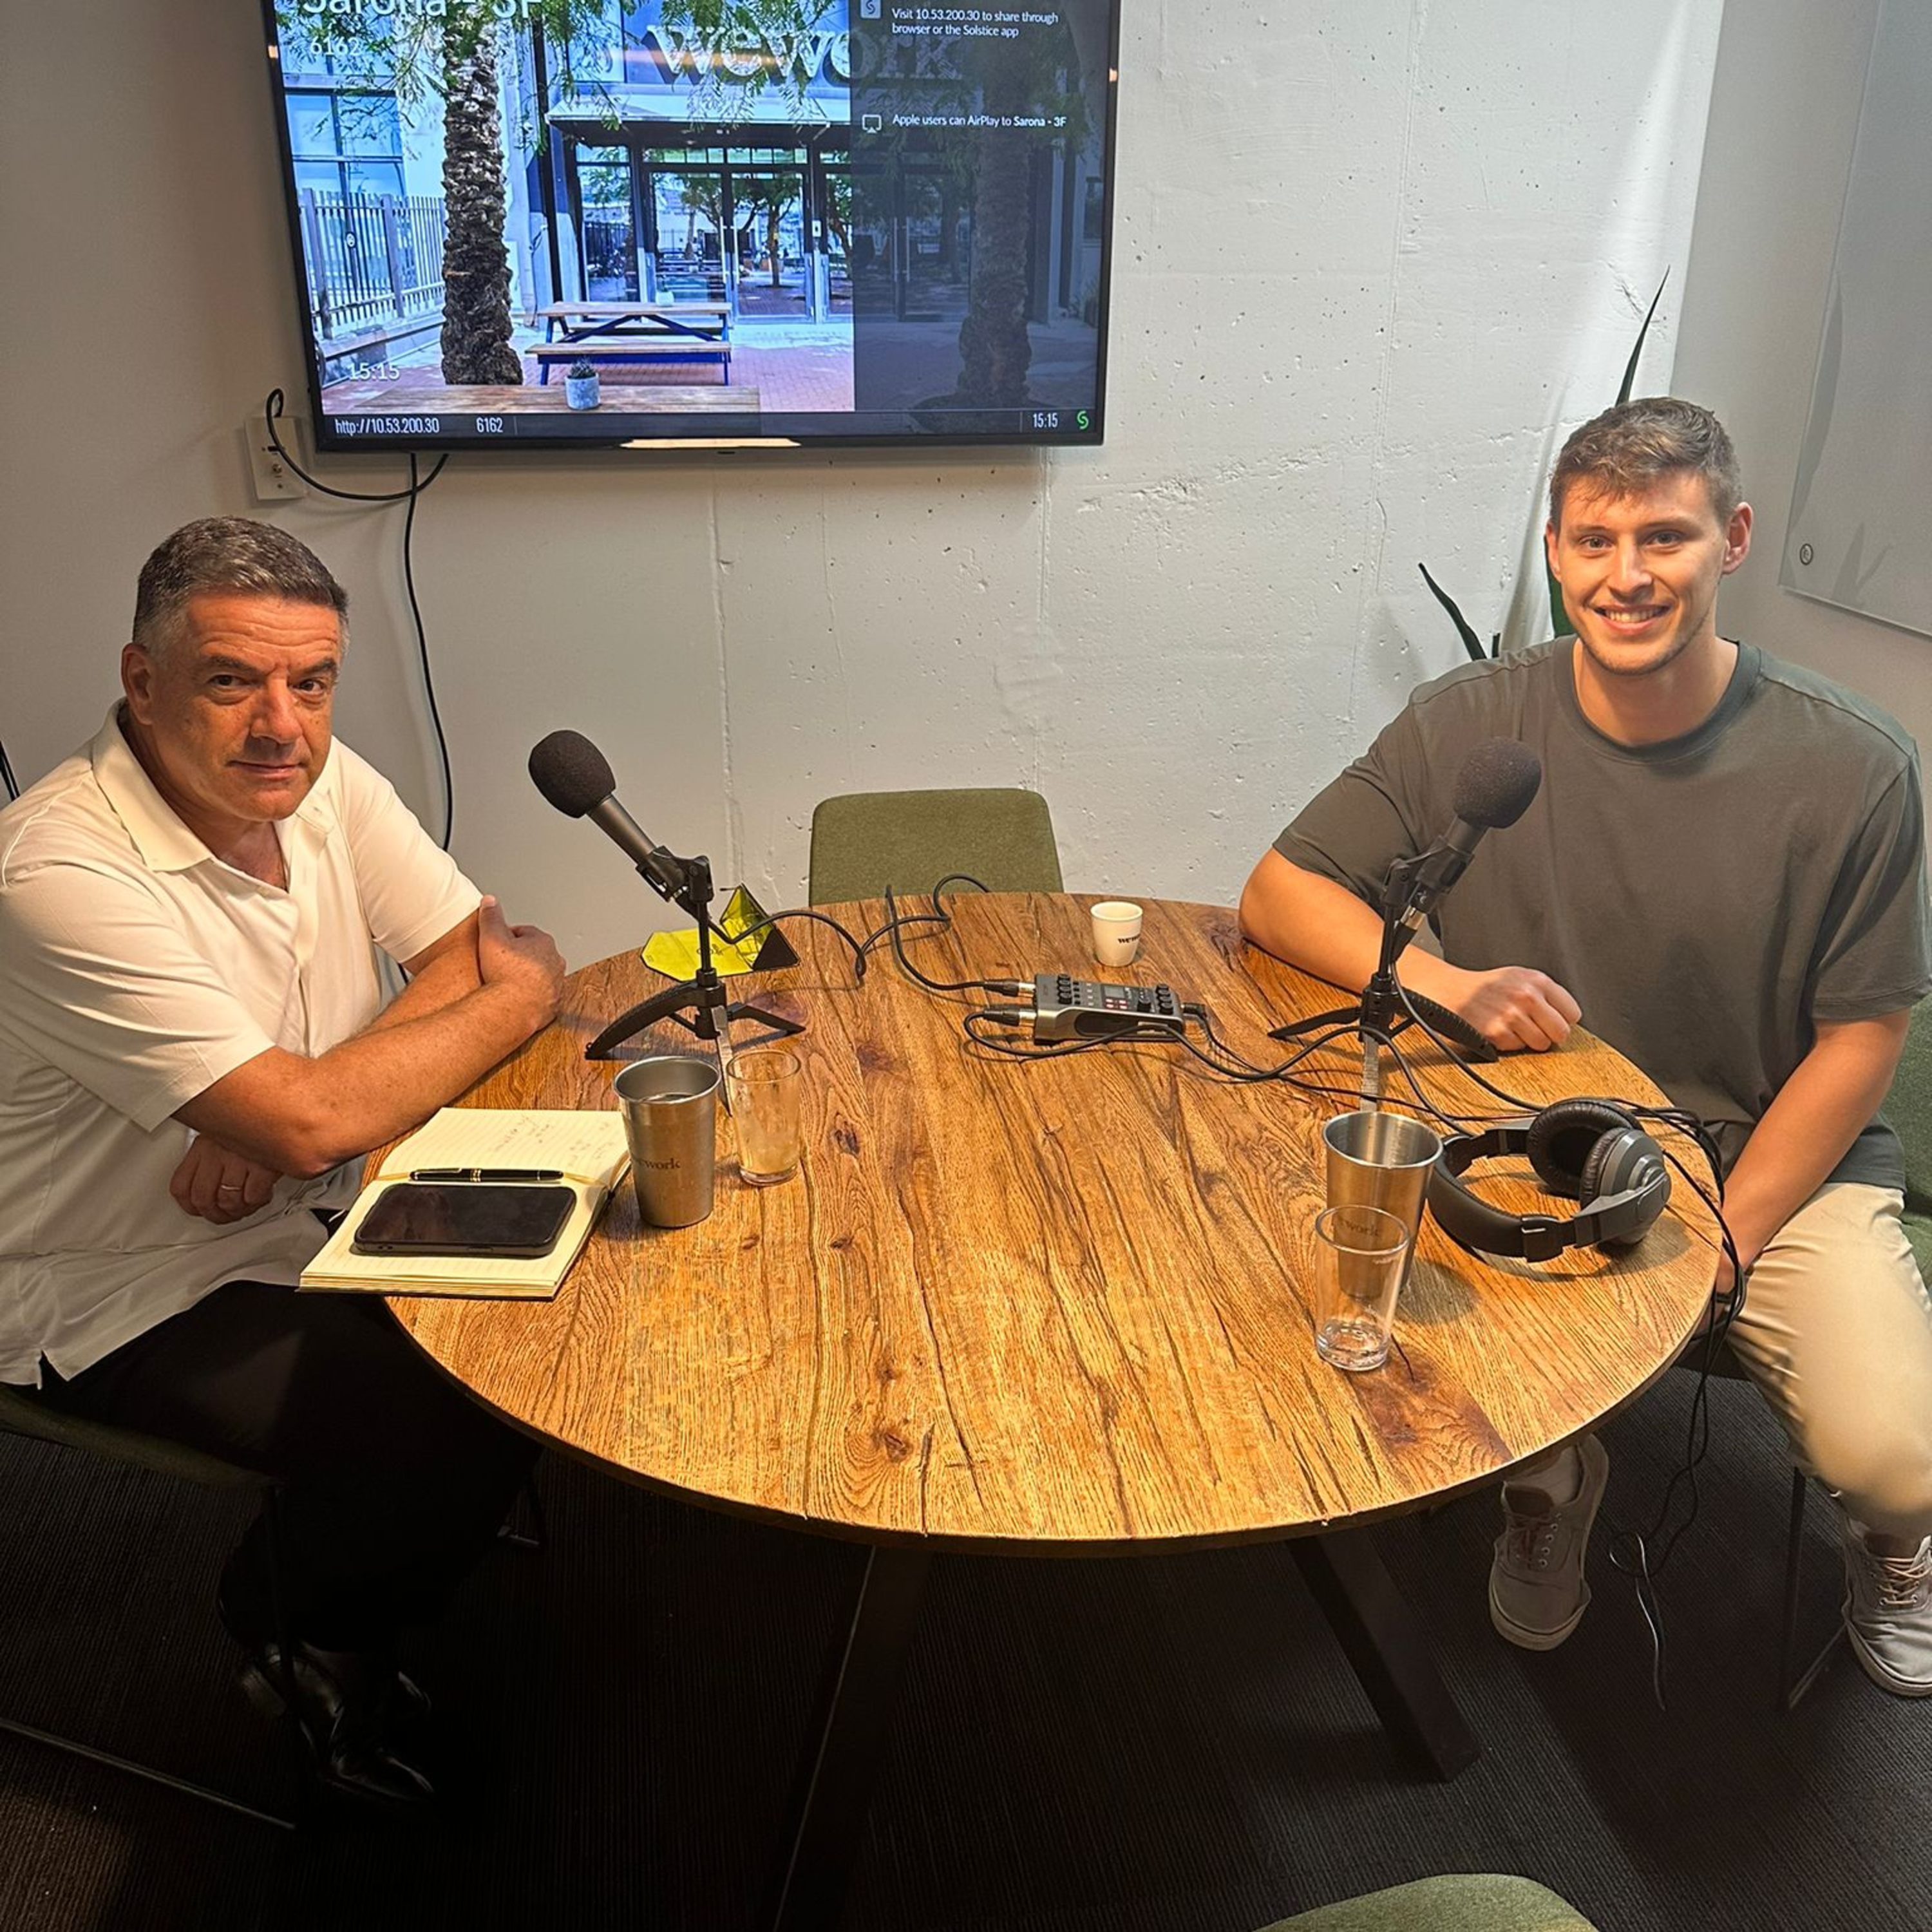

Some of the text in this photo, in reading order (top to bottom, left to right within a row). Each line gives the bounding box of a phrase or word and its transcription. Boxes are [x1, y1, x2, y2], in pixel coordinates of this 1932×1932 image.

[891, 8, 1059, 25] Visit 10.53.200.30 to share through
[891, 23, 1019, 39] browser or the Solstice app
[310, 36, 360, 55] 6162
[892, 115, 920, 127] Apple
[922, 117, 947, 126] users
[949, 117, 965, 126] can
[967, 115, 999, 128] AirPlay
[1001, 117, 1012, 126] to
[1013, 117, 1045, 127] Sarona
[1054, 117, 1066, 127] 3F
[348, 363, 401, 381] 15:15
[335, 417, 440, 436] http://10.53.200.30
[476, 417, 504, 433] 6162
[1033, 412, 1059, 428] 15:15
